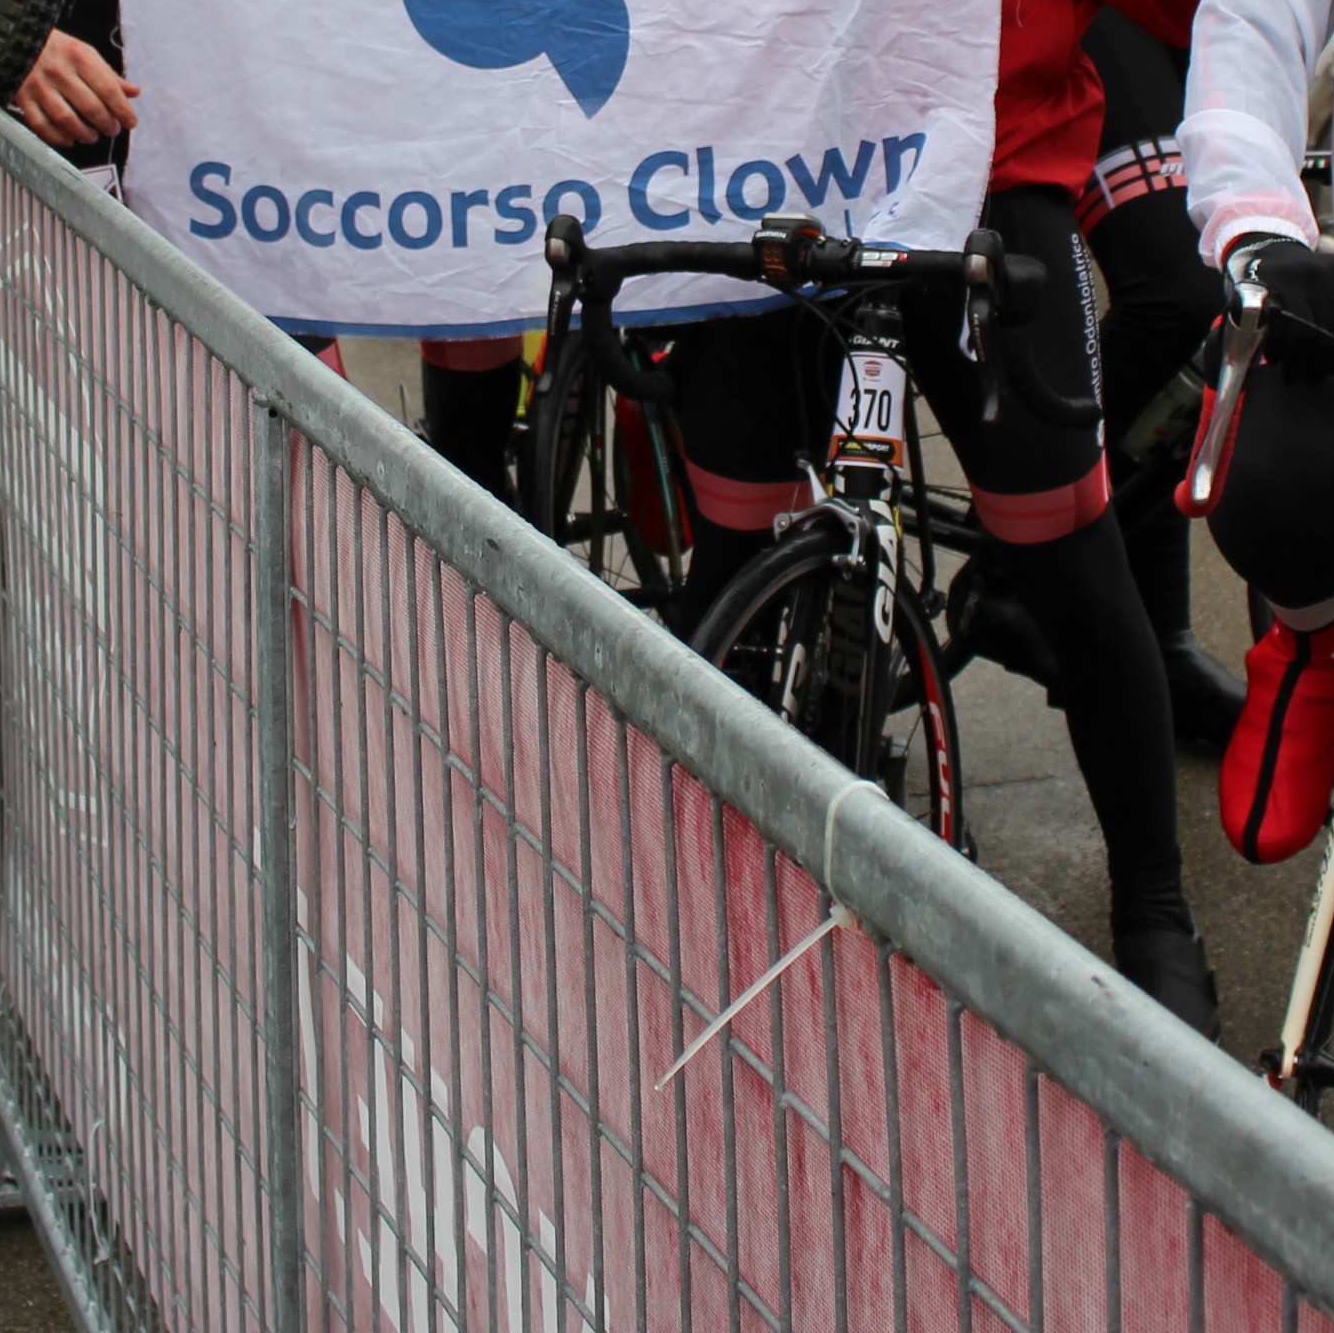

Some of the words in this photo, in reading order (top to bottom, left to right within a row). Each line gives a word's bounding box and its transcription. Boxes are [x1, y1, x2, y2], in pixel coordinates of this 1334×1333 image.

[189, 160, 602, 250] Soccorso
[628, 131, 929, 233] Clown
[754, 230, 788, 240] GARMIN
[1071, 232, 1097, 356] Odontoiatrico
[1091, 355, 1103, 409] entro
[848, 388, 892, 434] 370
